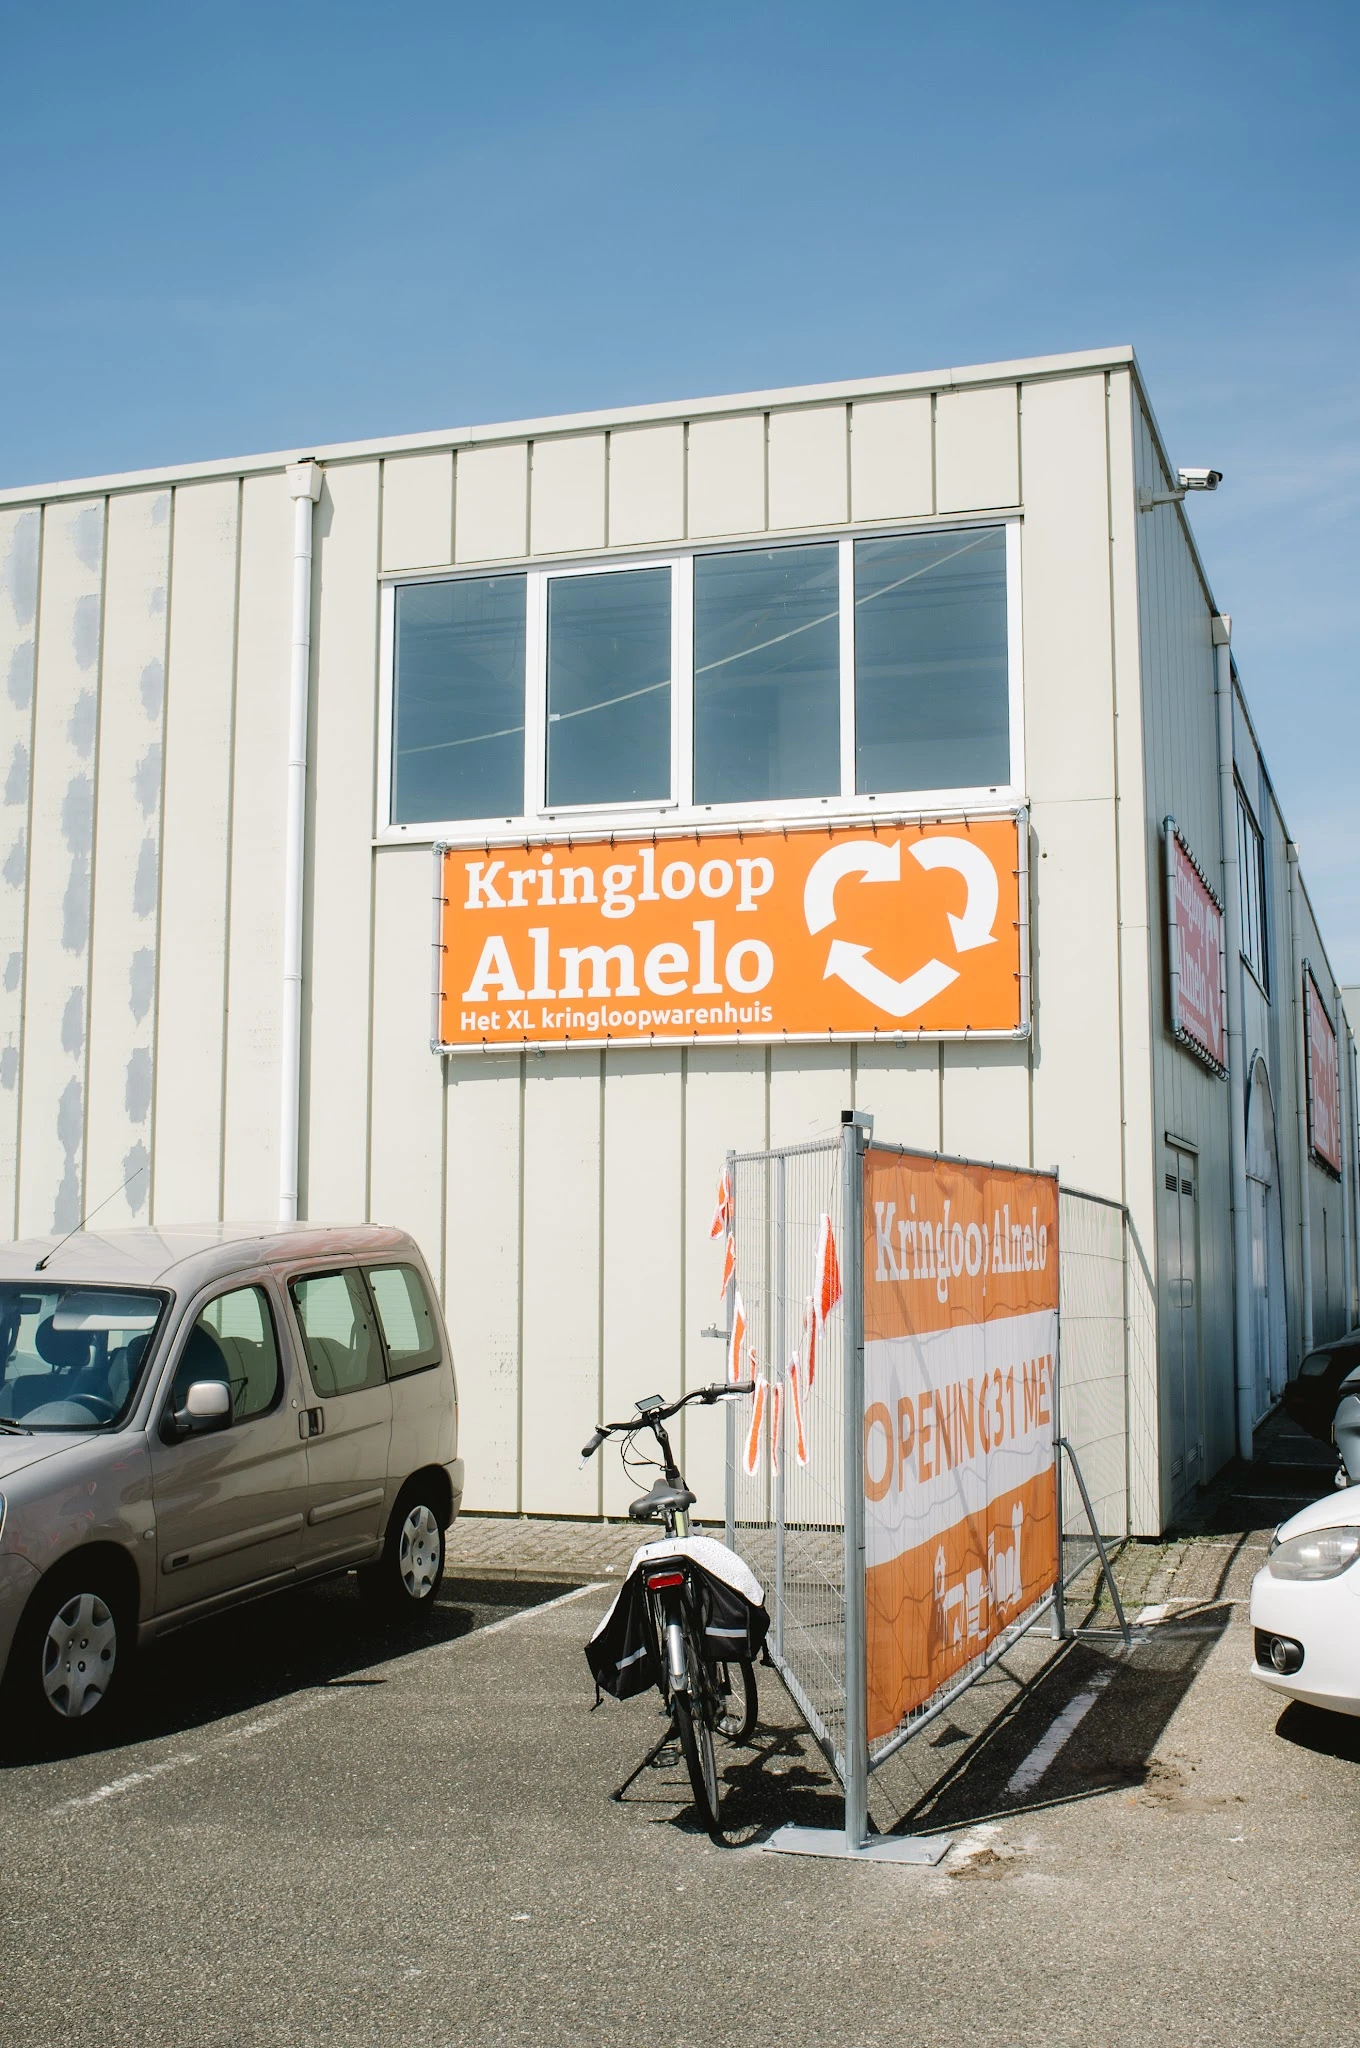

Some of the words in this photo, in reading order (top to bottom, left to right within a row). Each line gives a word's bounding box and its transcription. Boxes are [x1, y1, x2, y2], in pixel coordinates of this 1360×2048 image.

[463, 848, 775, 919] Kringloop
[461, 919, 775, 1002] Almelo
[460, 1011, 501, 1031] Het
[506, 1009, 536, 1030] XL
[541, 1000, 774, 1033] kringloopwarenhuis
[991, 1203, 1048, 1274] Almelo
[993, 1365, 1015, 1447] 31
